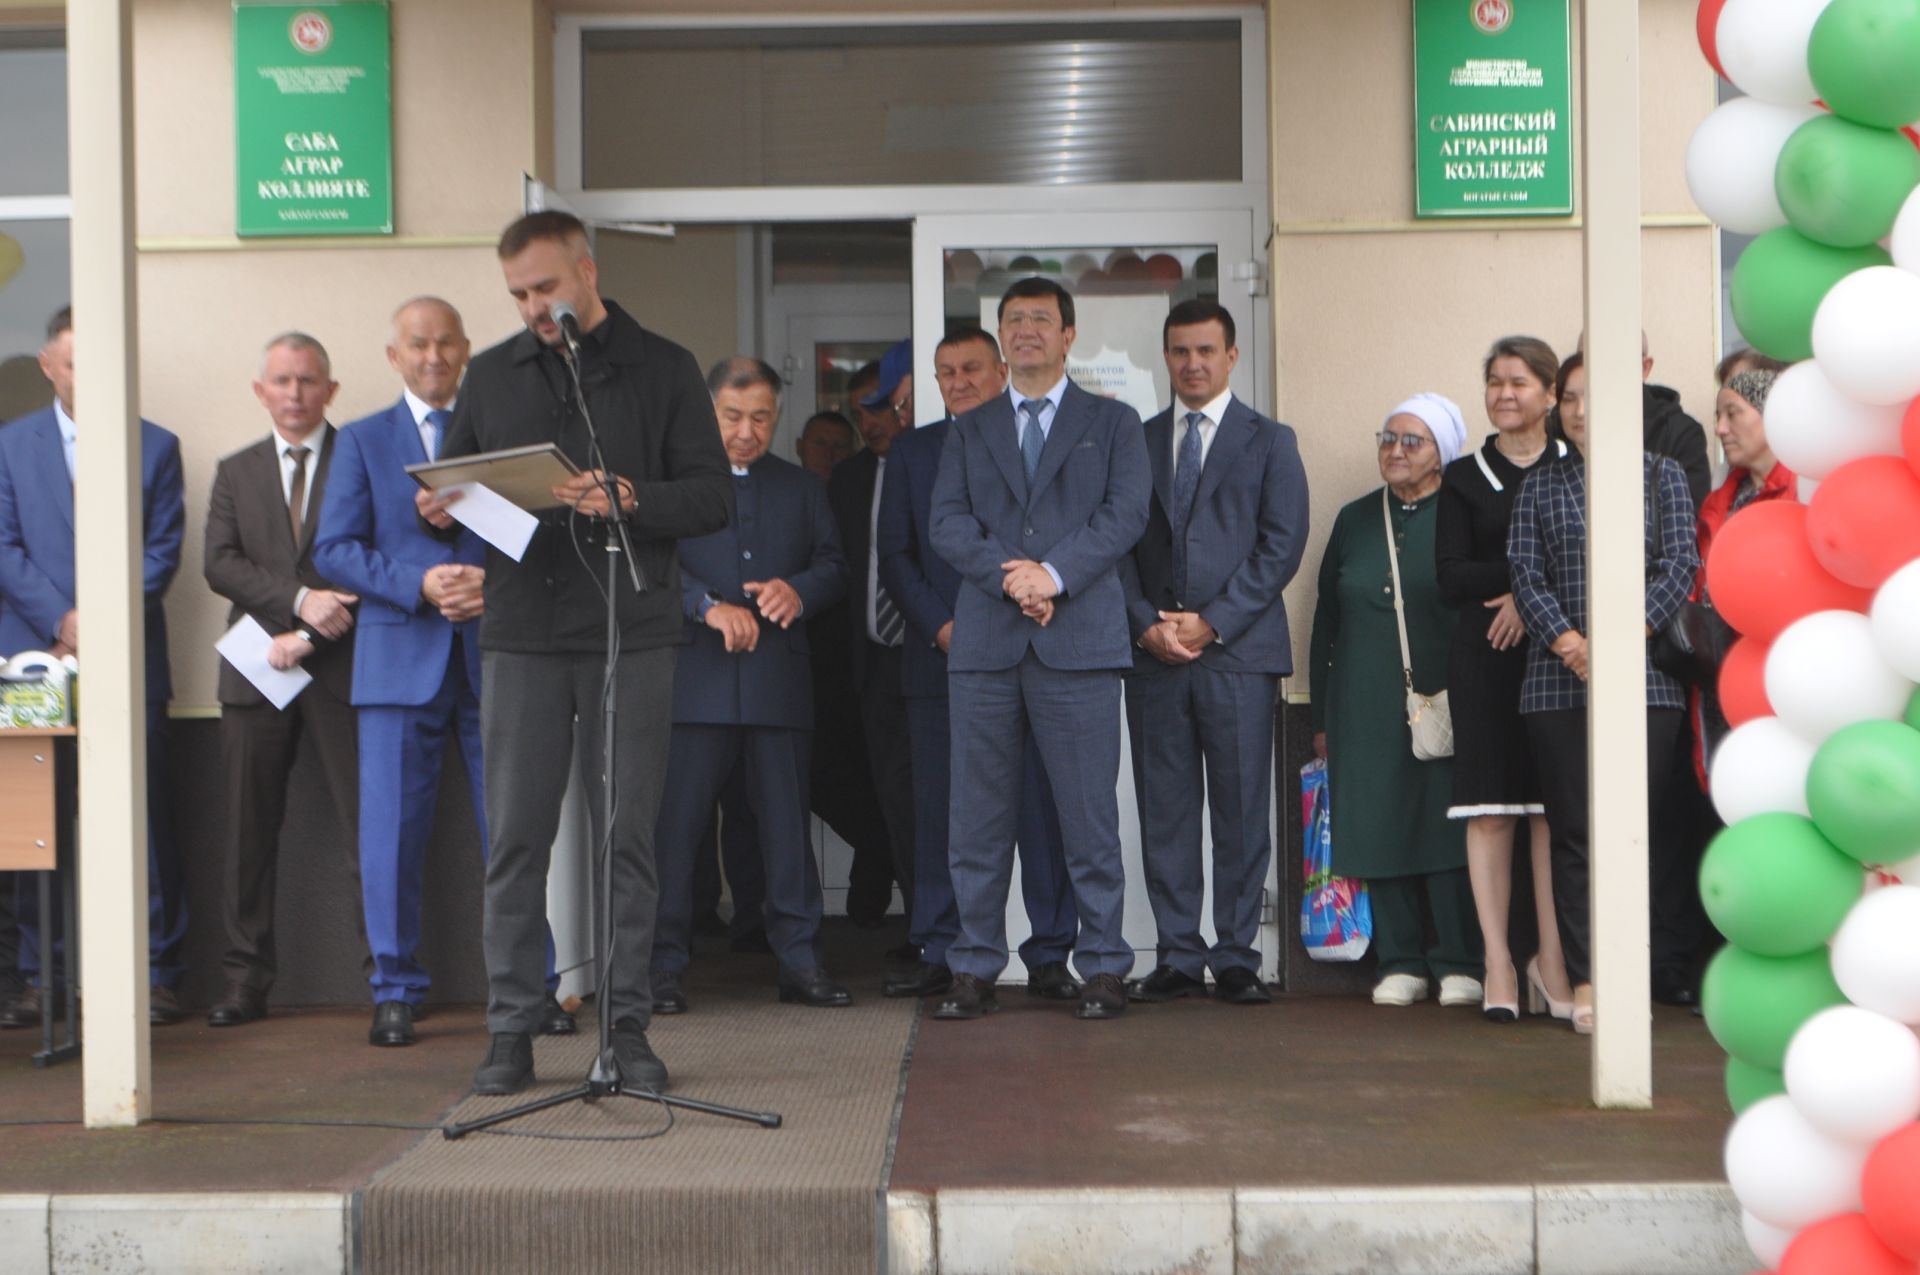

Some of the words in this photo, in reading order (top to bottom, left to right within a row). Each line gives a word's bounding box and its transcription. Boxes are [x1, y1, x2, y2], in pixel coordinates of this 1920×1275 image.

[1430, 107, 1556, 132] САБИНСКИЙ
[1440, 133, 1548, 156] АГРАРНЫЙ
[281, 156, 343, 175] АГРАР
[1445, 160, 1545, 180] КОЛЛЕДЖ
